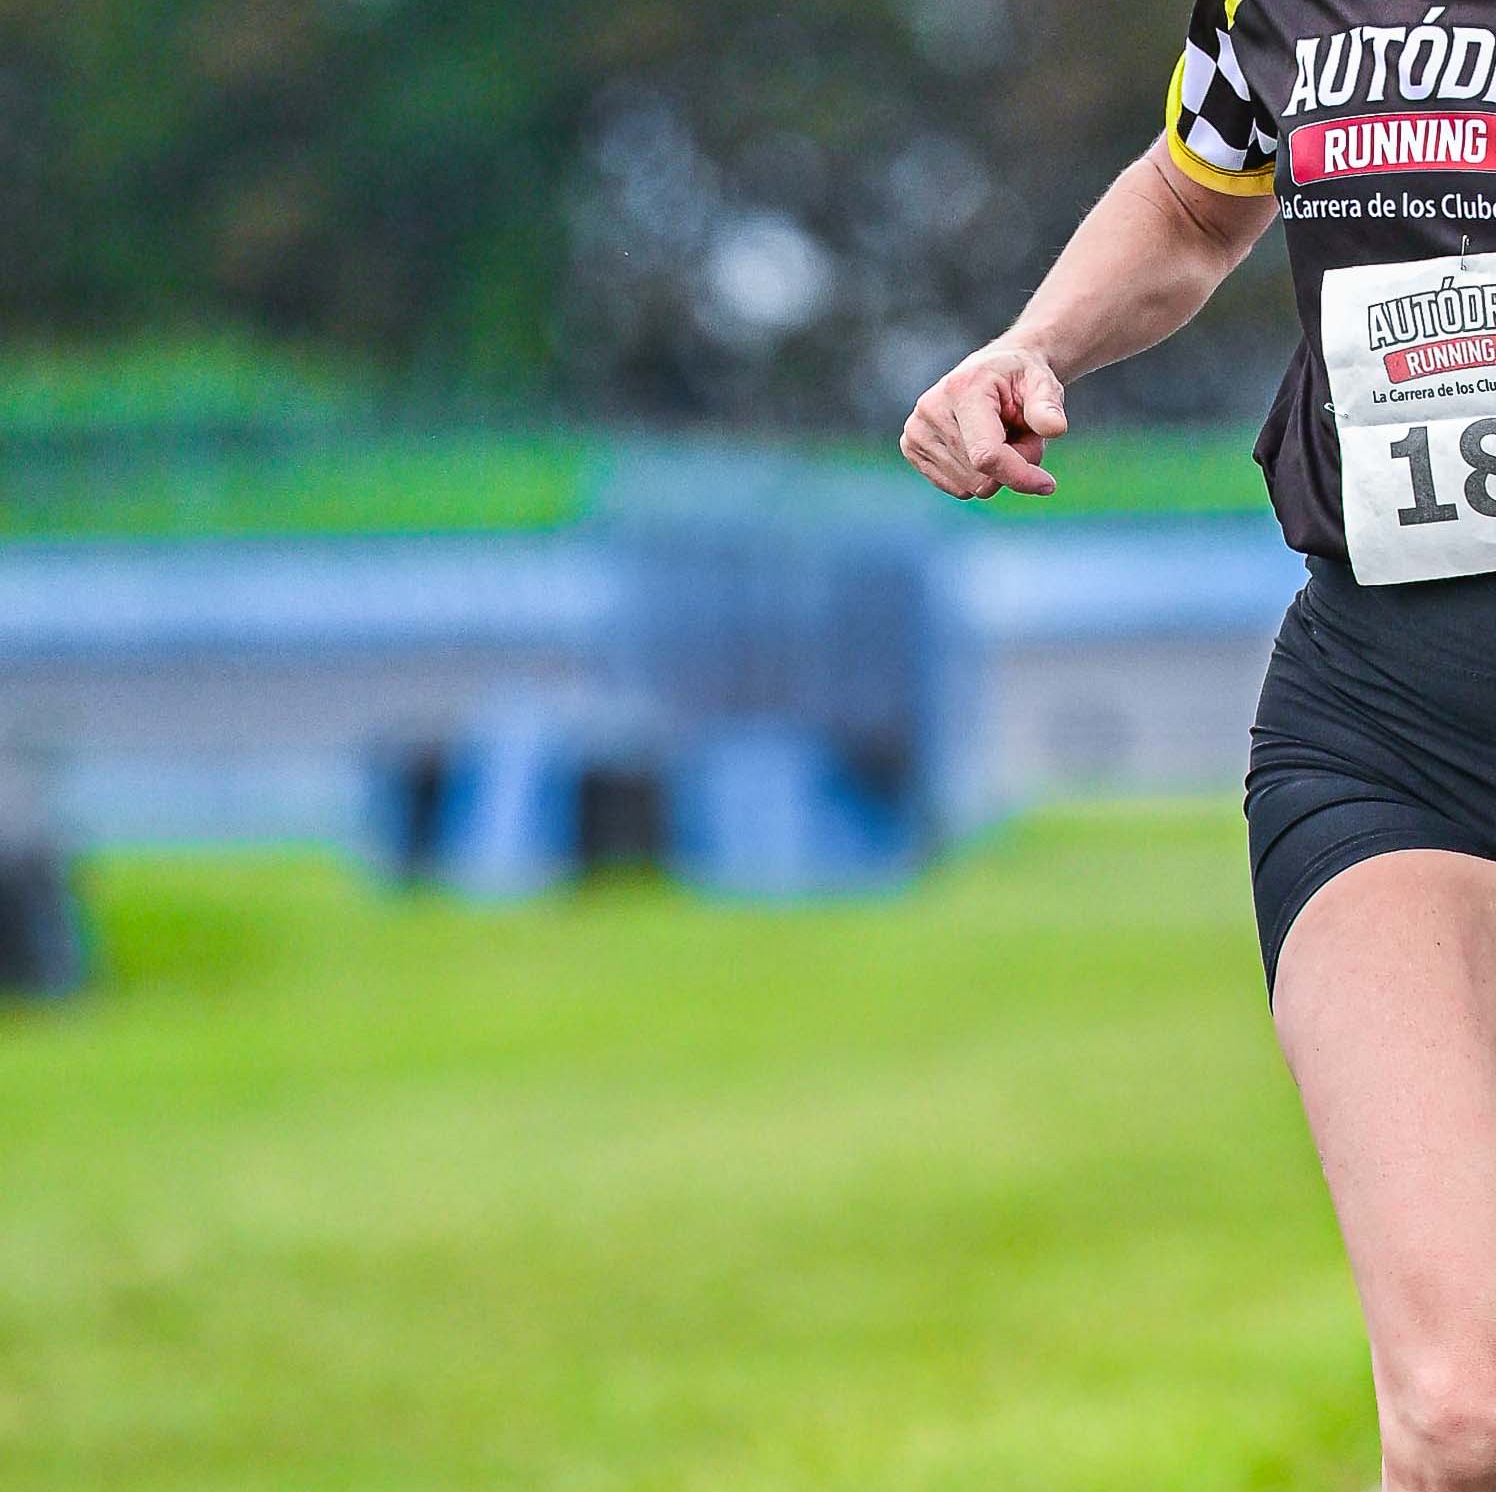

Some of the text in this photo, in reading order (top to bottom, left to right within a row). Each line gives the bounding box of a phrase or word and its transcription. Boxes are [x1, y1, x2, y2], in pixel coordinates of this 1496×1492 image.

[1323, 118, 1488, 174] RUNNING
[1294, 193, 1362, 219] Carrera
[1367, 192, 1396, 218] de
[1402, 192, 1436, 219] los
[1405, 338, 1496, 376] RUNNING
[1372, 390, 1387, 404] La
[1389, 387, 1435, 403] Carrera
[1437, 384, 1454, 396] de
[1456, 381, 1474, 395] los
